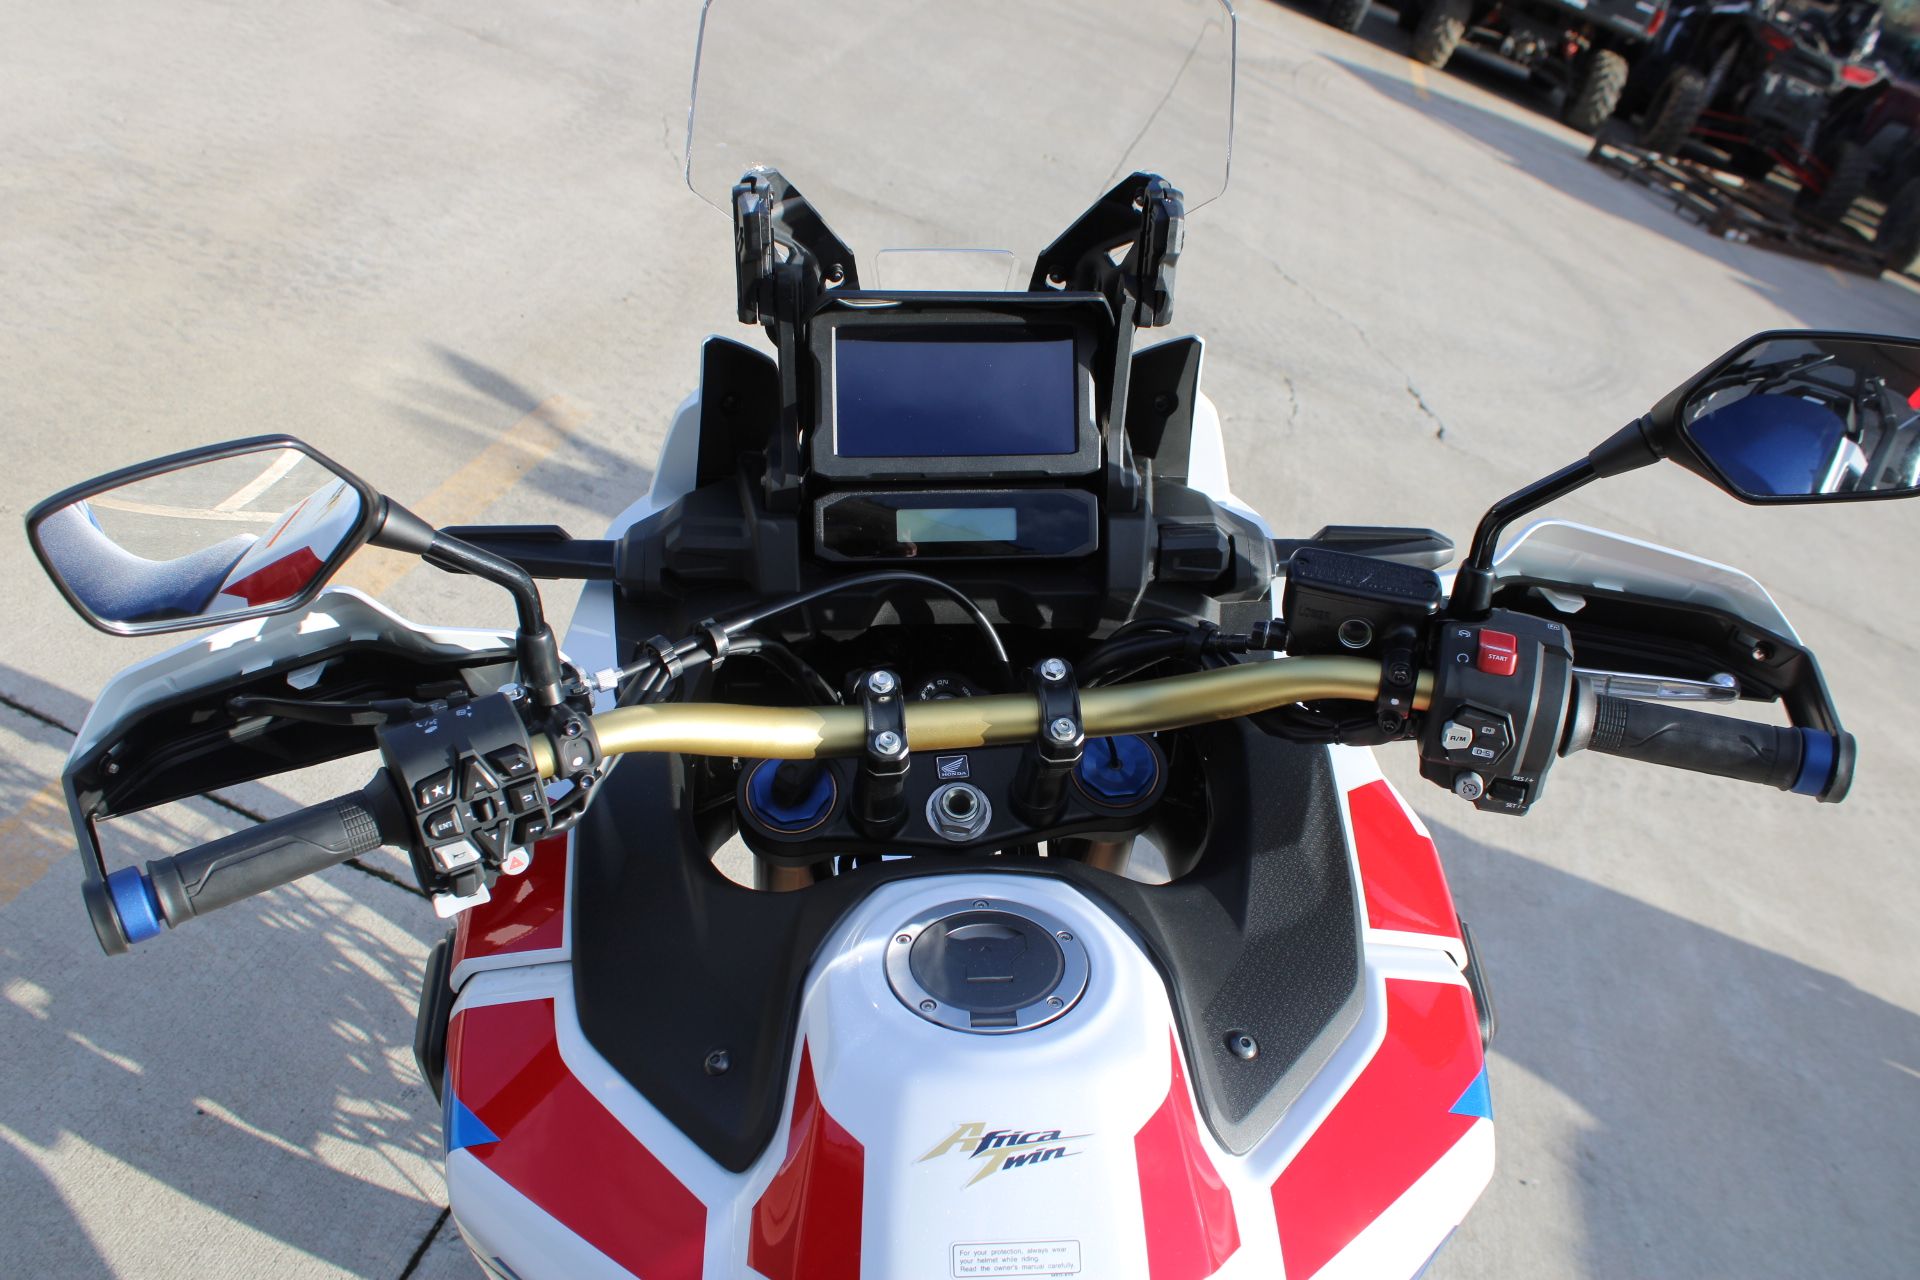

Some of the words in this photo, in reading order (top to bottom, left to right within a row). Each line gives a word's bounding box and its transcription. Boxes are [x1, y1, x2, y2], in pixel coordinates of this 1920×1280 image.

[1487, 653, 1508, 662] START
[438, 820, 453, 831] ENT
[911, 1121, 1095, 1165] Africa
[960, 1143, 1083, 1190] Twin
[1027, 1247, 1048, 1255] always
